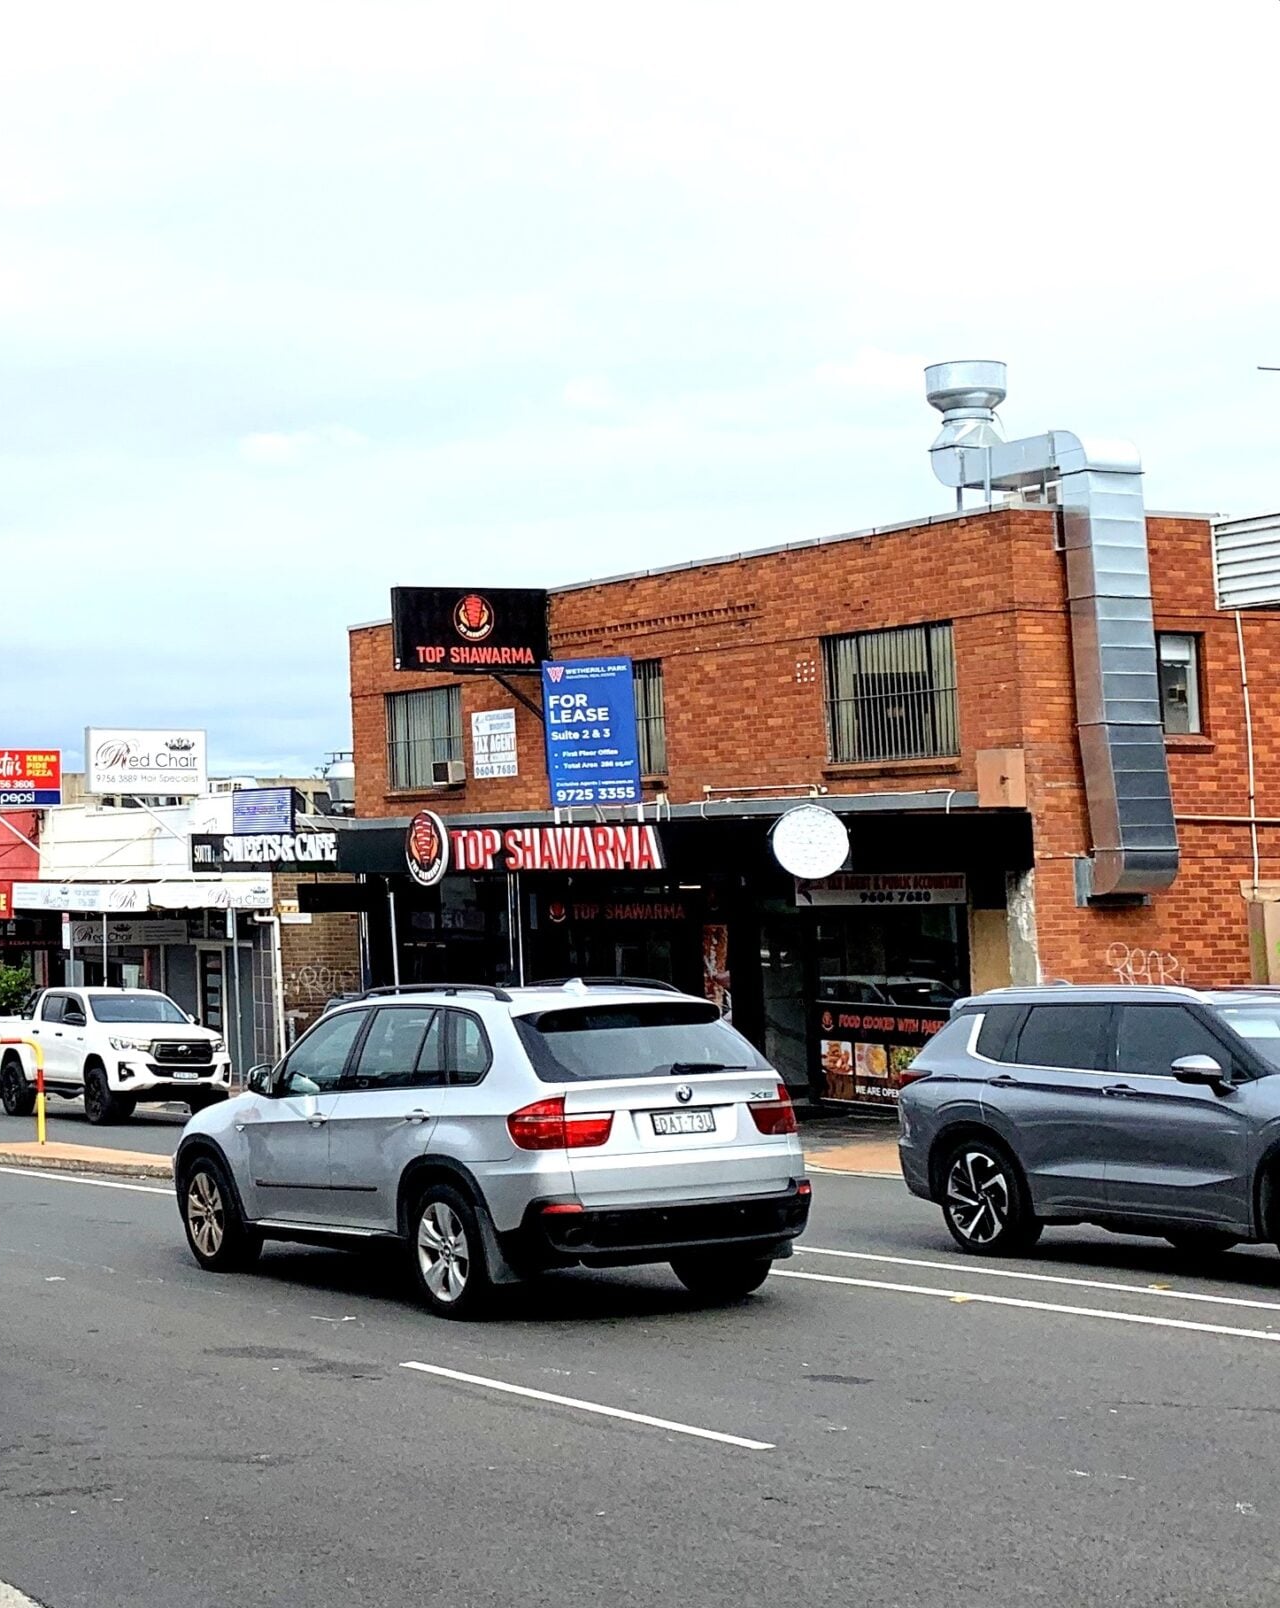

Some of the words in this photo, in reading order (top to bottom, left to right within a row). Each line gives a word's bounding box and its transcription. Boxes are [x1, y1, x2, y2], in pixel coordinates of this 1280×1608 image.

[416, 646, 445, 663] TOP
[450, 646, 535, 664] SHAWARMA
[549, 693, 587, 709] FOR
[550, 707, 609, 724] LEASE
[551, 730, 579, 740] Suite
[582, 729, 590, 739] 2
[592, 729, 600, 738] &
[603, 728, 611, 738] 3
[474, 735, 489, 754] TAX
[490, 733, 515, 752] AGENT
[95, 739, 150, 770] Red
[155, 752, 198, 768] Chair
[0, 791, 35, 804] pepsi
[557, 788, 594, 801] 9725
[598, 787, 635, 799] 3355
[449, 828, 501, 870] TOP
[505, 825, 665, 870] SHAWARMA
[573, 903, 598, 919] TOP
[605, 902, 686, 920] SHAWARMA
[839, 1014, 860, 1028] FOOD
[863, 1016, 895, 1031] COOKED
[897, 1018, 919, 1032] WITH
[855, 1085, 866, 1094] WE
[867, 1086, 881, 1096] ARE
